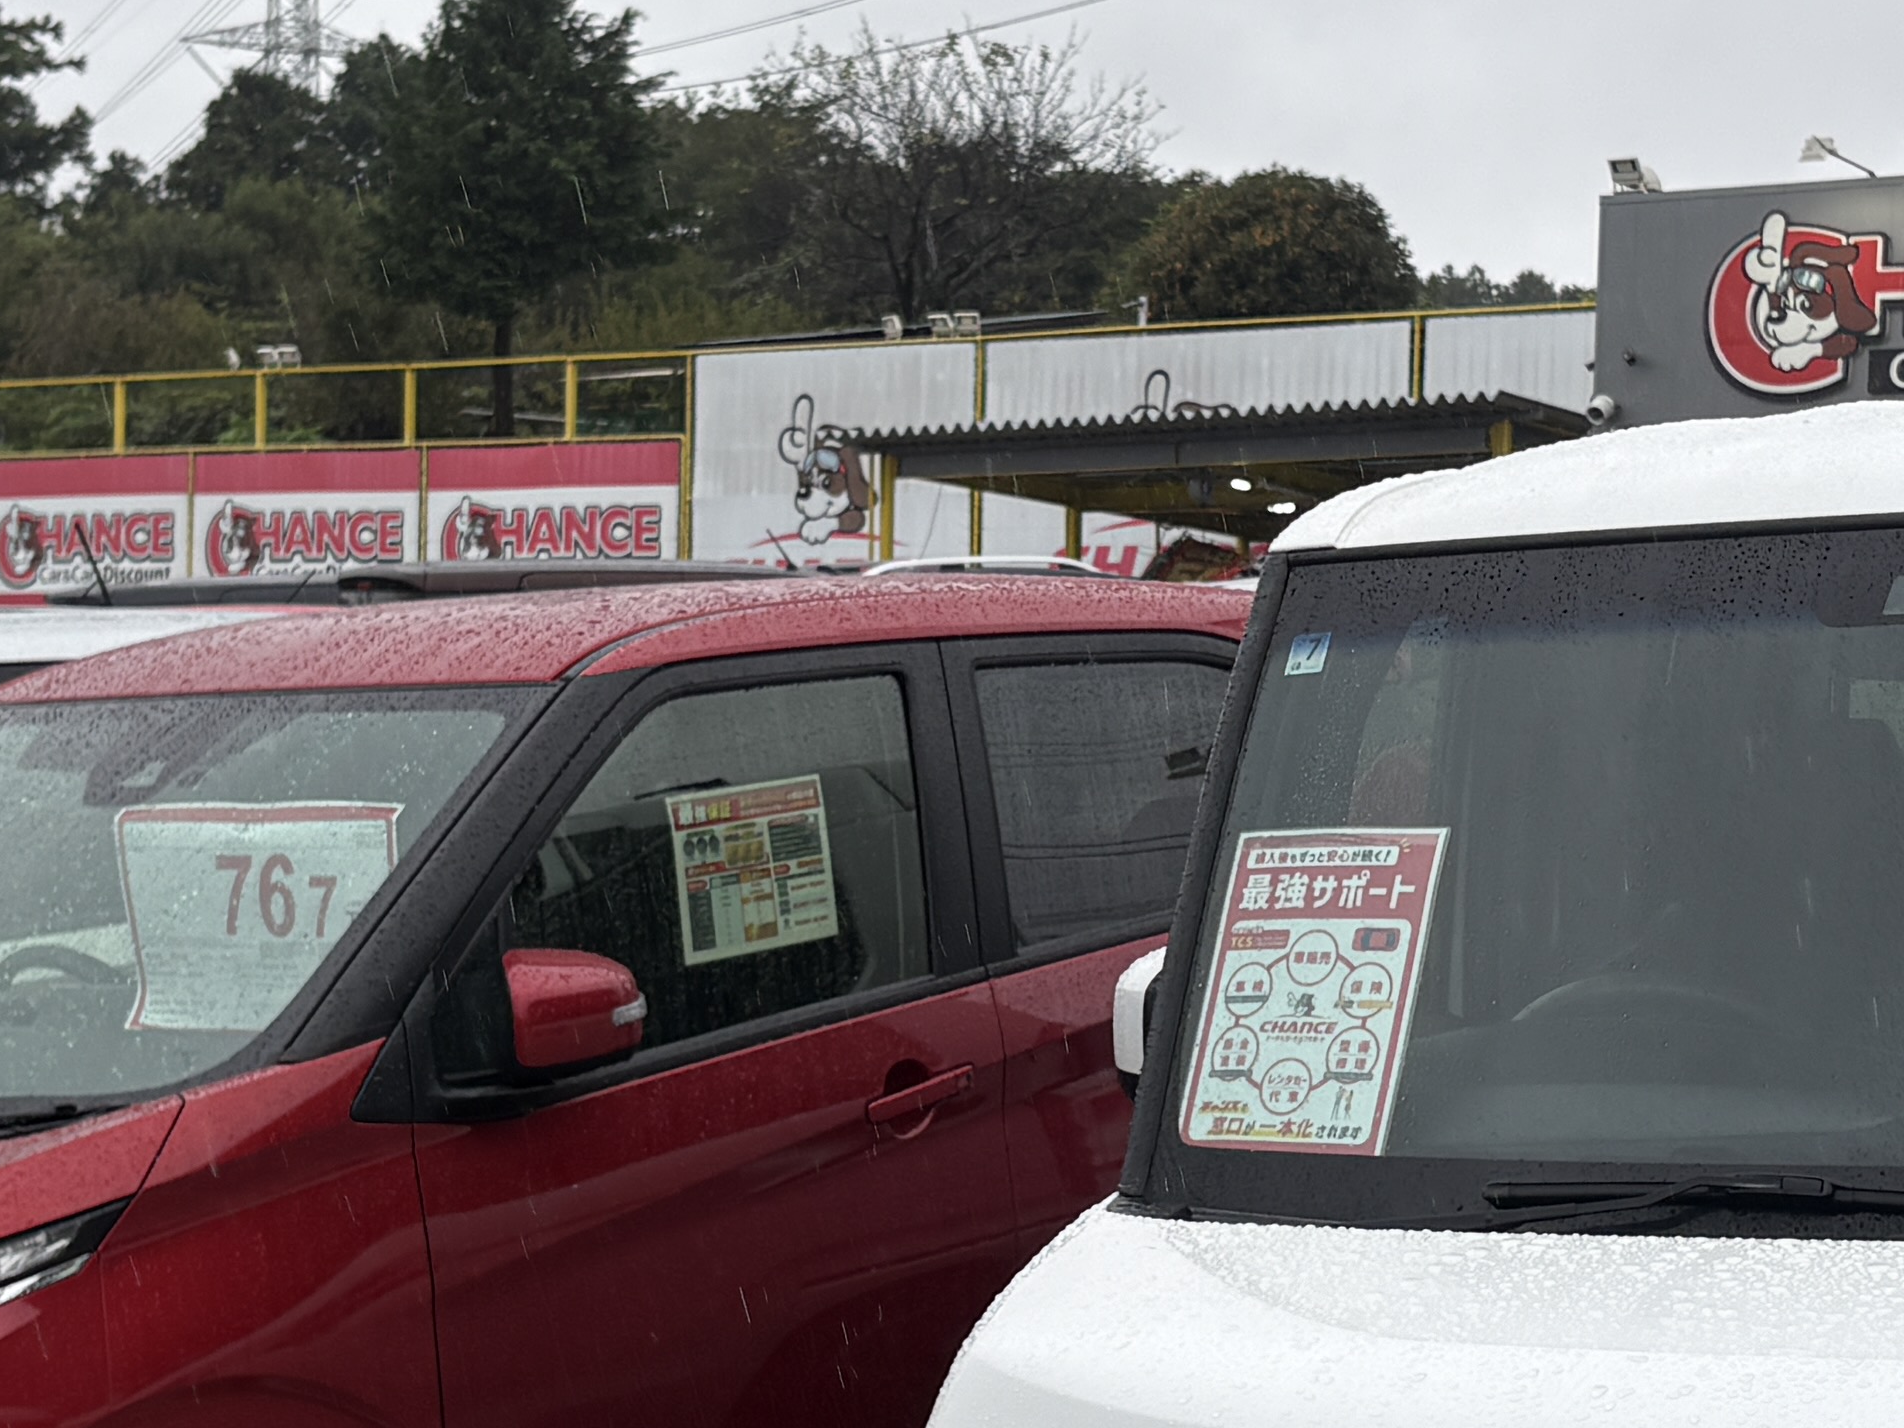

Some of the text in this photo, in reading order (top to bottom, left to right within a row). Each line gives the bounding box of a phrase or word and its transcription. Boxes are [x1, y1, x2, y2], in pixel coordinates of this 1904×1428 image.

[206, 504, 404, 577] CHANCE
[442, 504, 662, 561] CHANCE
[1306, 637, 1322, 660] 7
[1238, 870, 1416, 910] 最強サポート
[1259, 1020, 1339, 1035] CHANCE
